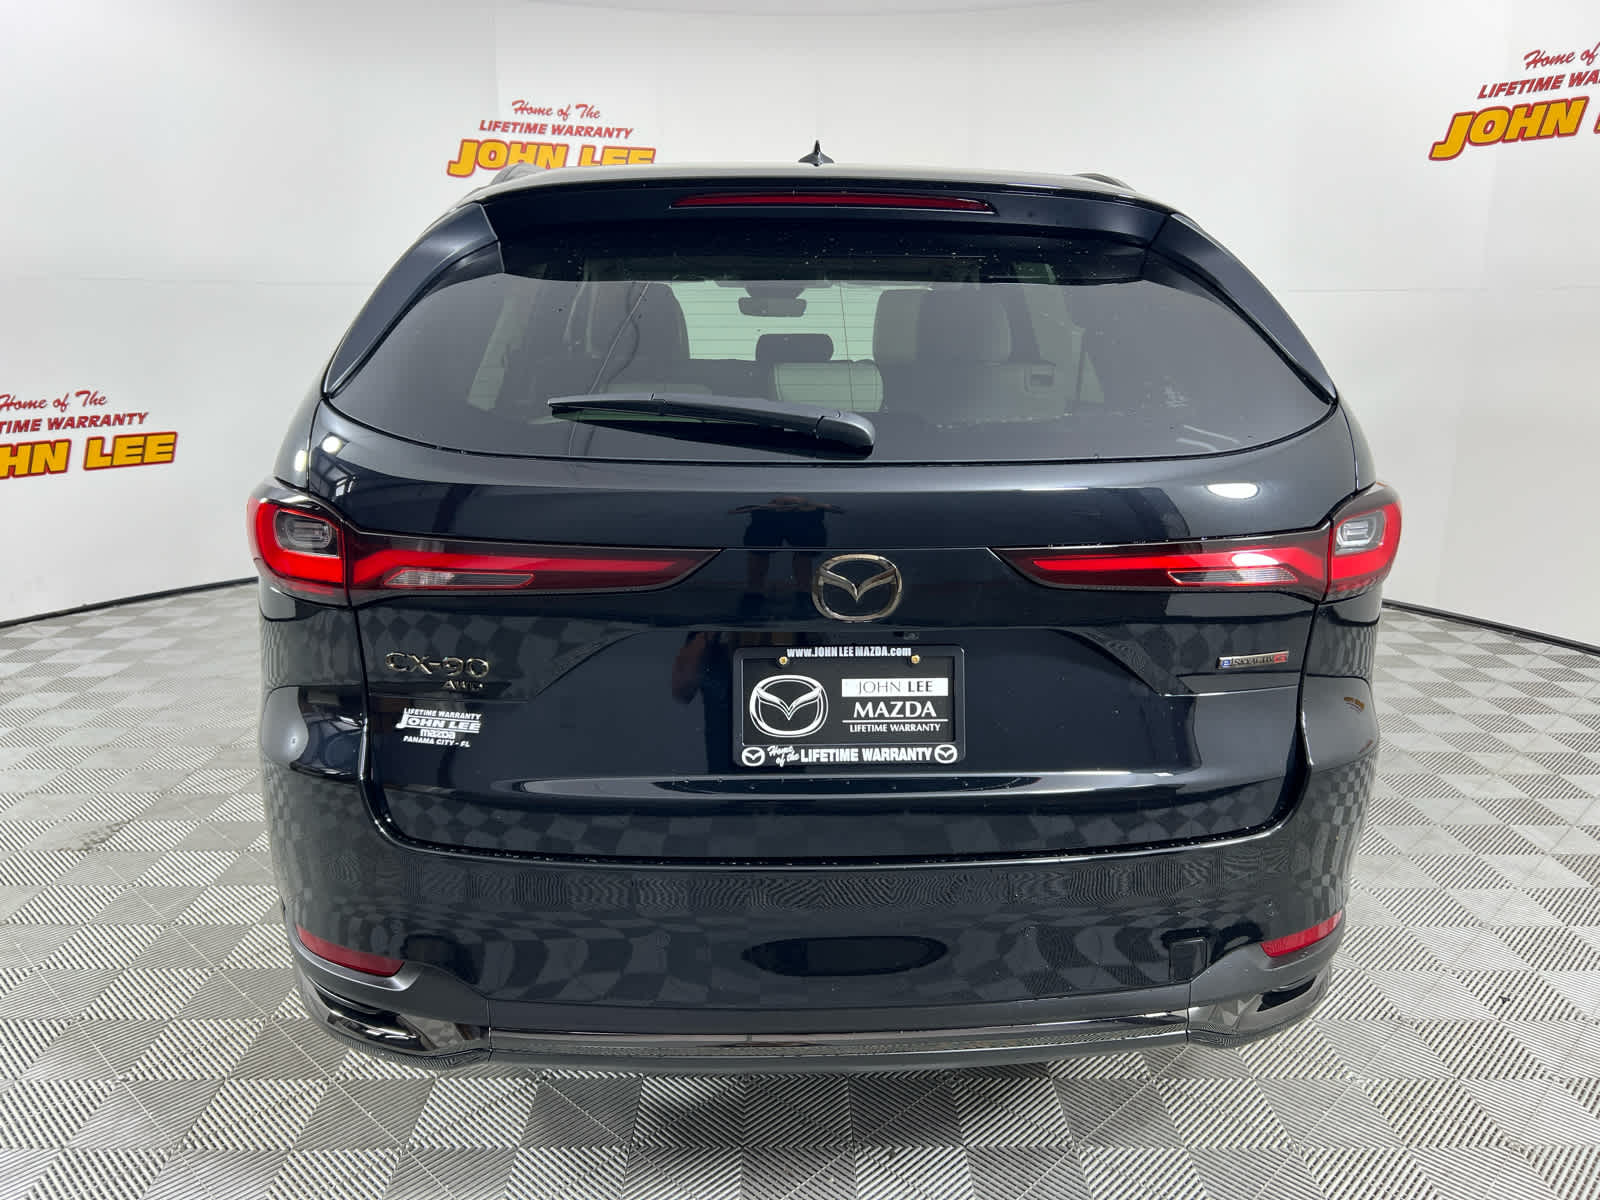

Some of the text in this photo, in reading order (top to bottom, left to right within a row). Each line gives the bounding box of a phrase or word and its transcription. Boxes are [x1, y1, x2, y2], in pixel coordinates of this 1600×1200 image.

[1523, 41, 1600, 71] Home of
[1477, 74, 1566, 100] LIFETIME
[511, 99, 601, 121] Home of The
[478, 119, 634, 140] LIFETIME WARRANTY
[1428, 96, 1590, 161] JOHN
[446, 138, 570, 178] JOHN
[0, 390, 107, 412] Home of The
[0, 411, 149, 435] TIME WARRANTY
[0, 431, 178, 480] HN LEE
[839, 646, 854, 657] LEE
[855, 646, 912, 657] MAZDA.com
[384, 651, 490, 678] CX-90
[858, 681, 933, 695] JOHN LEE
[404, 707, 482, 720] LIFETIME WARRANTY
[853, 701, 937, 718] MAZDA
[395, 713, 481, 731] JOHN LEE
[849, 723, 941, 733] LIFETIME WARRANTY
[402, 735, 435, 745] PANAMA
[436, 737, 455, 747] CITY
[460, 740, 471, 748] FL
[800, 747, 932, 762] LIFETIME WARRANTY
